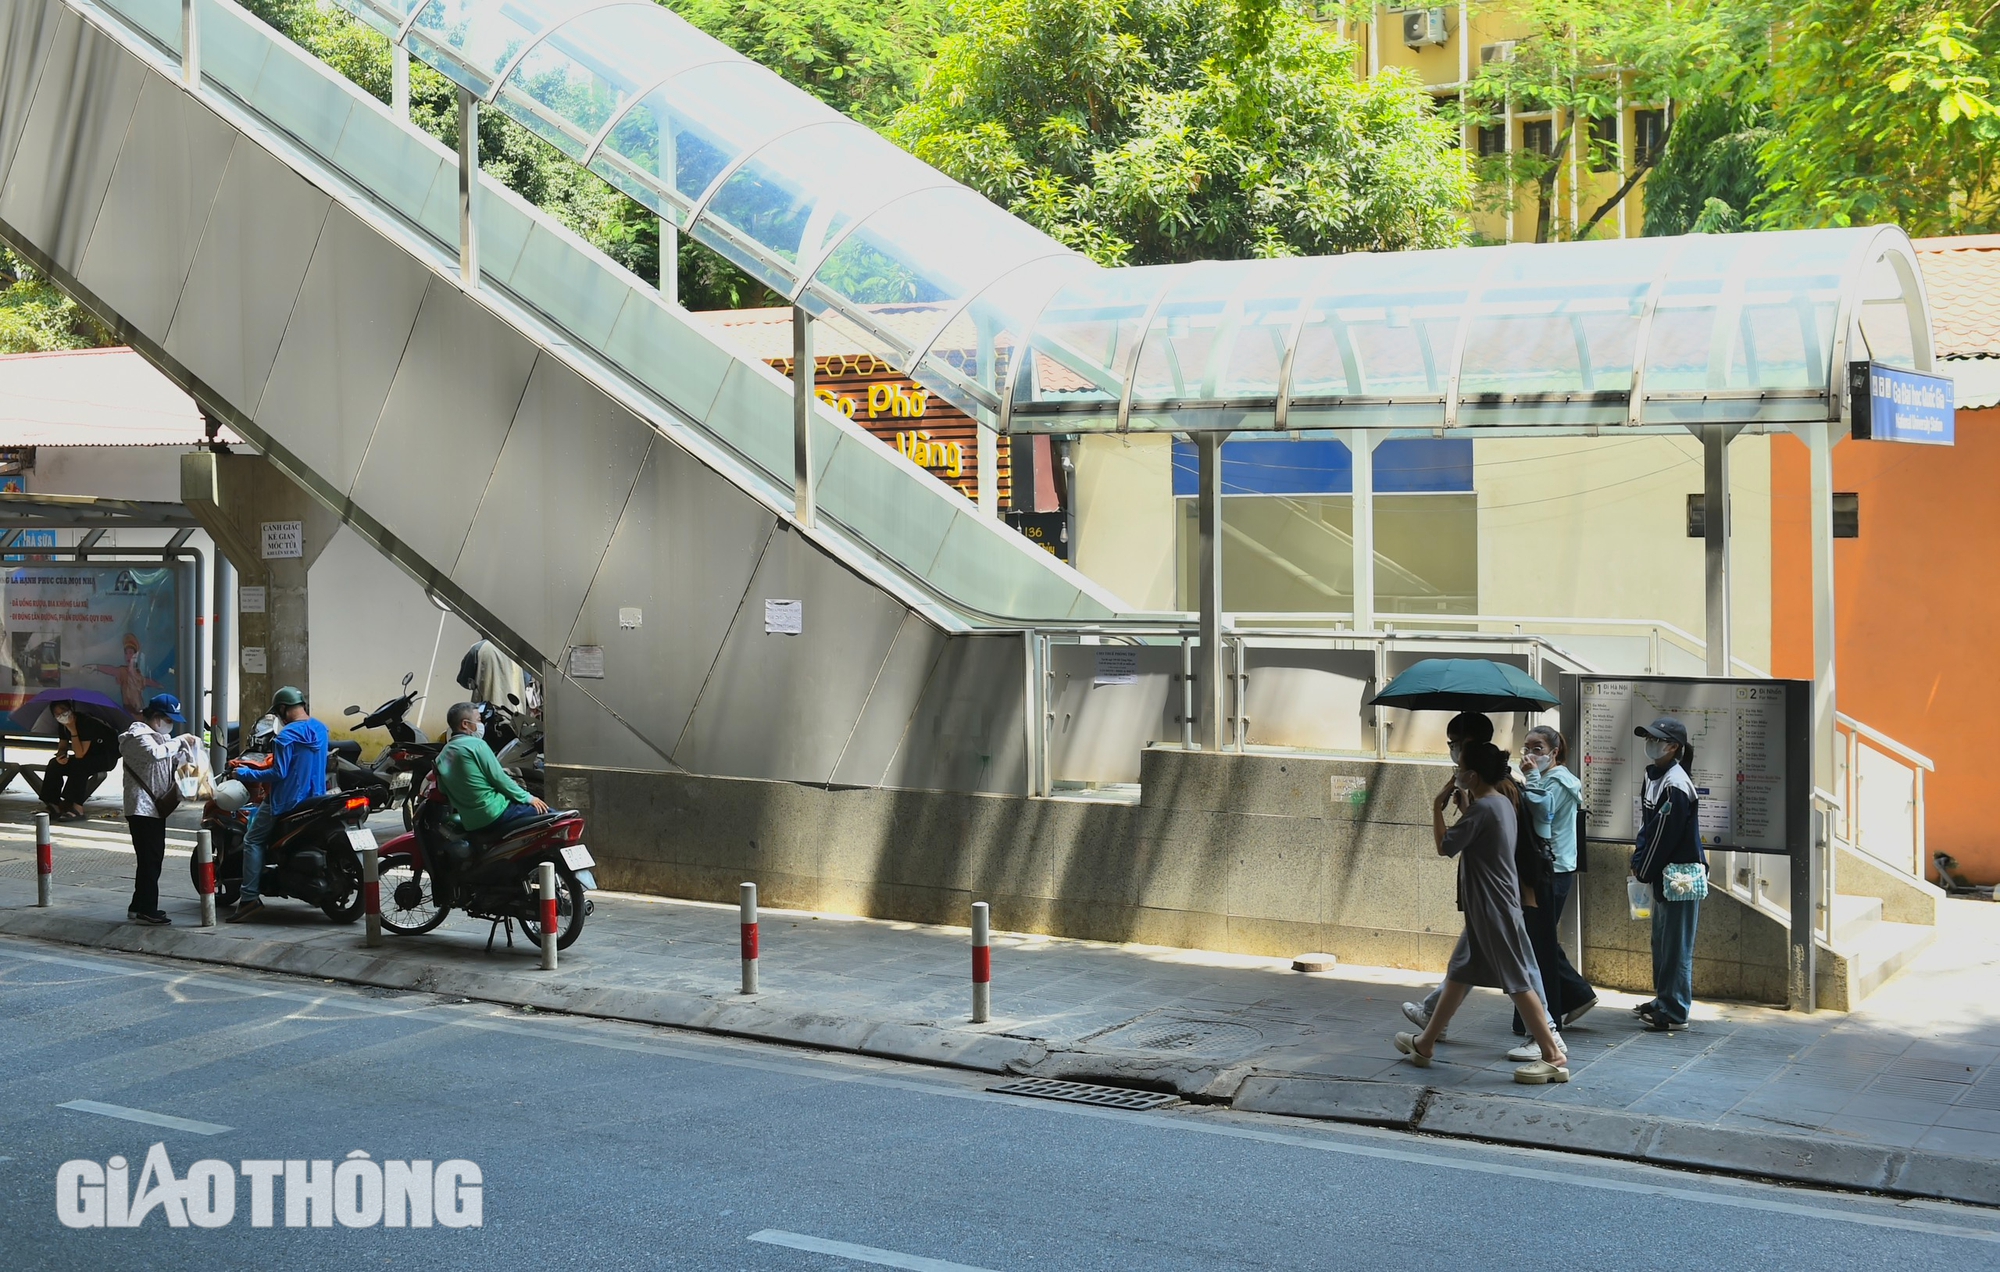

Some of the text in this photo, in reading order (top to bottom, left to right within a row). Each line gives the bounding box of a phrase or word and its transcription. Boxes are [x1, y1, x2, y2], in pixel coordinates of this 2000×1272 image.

[896, 430, 963, 478] Vàng
[283, 522, 300, 530] GIÁC
[1025, 526, 1043, 538] 136
[1597, 684, 1601, 694] 1
[1750, 688, 1757, 699] 2
